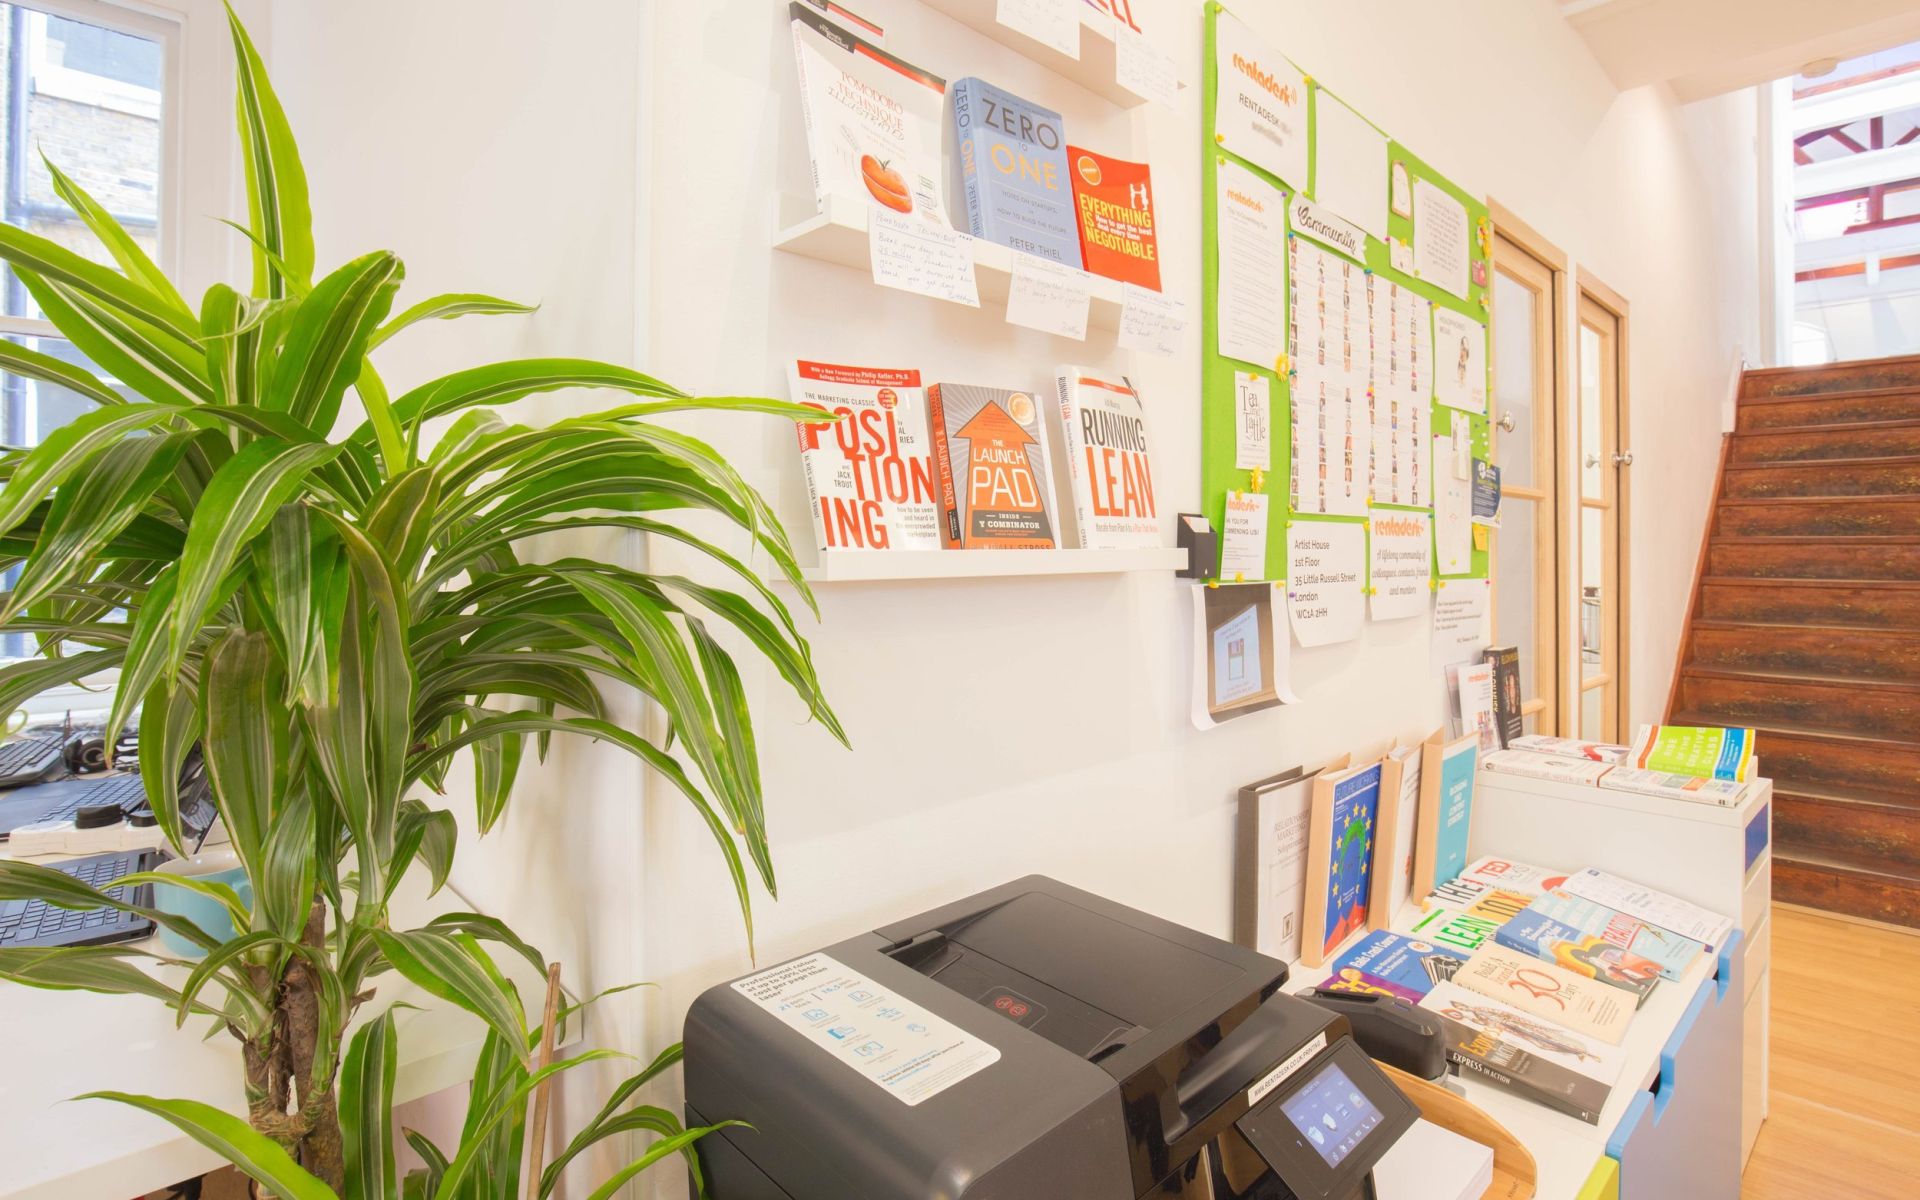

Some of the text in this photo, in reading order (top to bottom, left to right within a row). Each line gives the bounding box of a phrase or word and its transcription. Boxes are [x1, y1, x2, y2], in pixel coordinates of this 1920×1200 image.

[956, 84, 970, 128] ZERO
[1239, 92, 1280, 126] RENTADESK
[982, 98, 1059, 151] ZERO
[961, 139, 977, 177] ONE
[1018, 142, 1028, 152] TO
[991, 143, 1057, 191] ONE
[967, 183, 978, 211] PETER
[1079, 192, 1152, 229] EVERYTHING
[1082, 210, 1094, 227] IS
[1297, 205, 1357, 256] Community
[1009, 236, 1063, 261] PETER THIEL
[1085, 226, 1155, 261] NEGOTIABLE
[861, 371, 876, 380] Philip
[876, 379, 903, 387] Management
[805, 392, 817, 400] THE
[818, 394, 850, 405] MARKETING
[851, 398, 875, 407] CLASSIC
[1058, 376, 1070, 405] RUNNING
[1240, 385, 1258, 411] Tea
[1062, 404, 1073, 421] LEAN
[899, 436, 914, 444] RIES
[992, 439, 1004, 447] THE
[1080, 408, 1147, 453] RUNNING
[973, 447, 1026, 465] LAUNCH
[834, 480, 853, 488] TROUT
[837, 471, 851, 480] JACK
[844, 453, 937, 504] TION
[936, 440, 954, 506] LAUNCH PAD
[971, 466, 1038, 508] PAD
[1085, 446, 1157, 519] LEAN
[820, 496, 889, 549] ING
[979, 520, 1041, 529] Y COMBINATOR
[1295, 540, 1330, 550] Artist House
[1295, 556, 1320, 567] 1st Floor
[1295, 572, 1356, 586] 35 Little Russell Street
[1295, 592, 1319, 602] London
[1296, 608, 1328, 619] WC1A 2HH
[1474, 861, 1511, 877] TED
[1434, 914, 1499, 949] LEAN
[739, 958, 817, 988] Professional colour
[753, 966, 828, 997] cost per page than
[1508, 968, 1565, 1011] 30
[1453, 1053, 1483, 1072] EXPRESS
[1483, 1067, 1490, 1075] IN
[1490, 1070, 1511, 1085] ACTION
